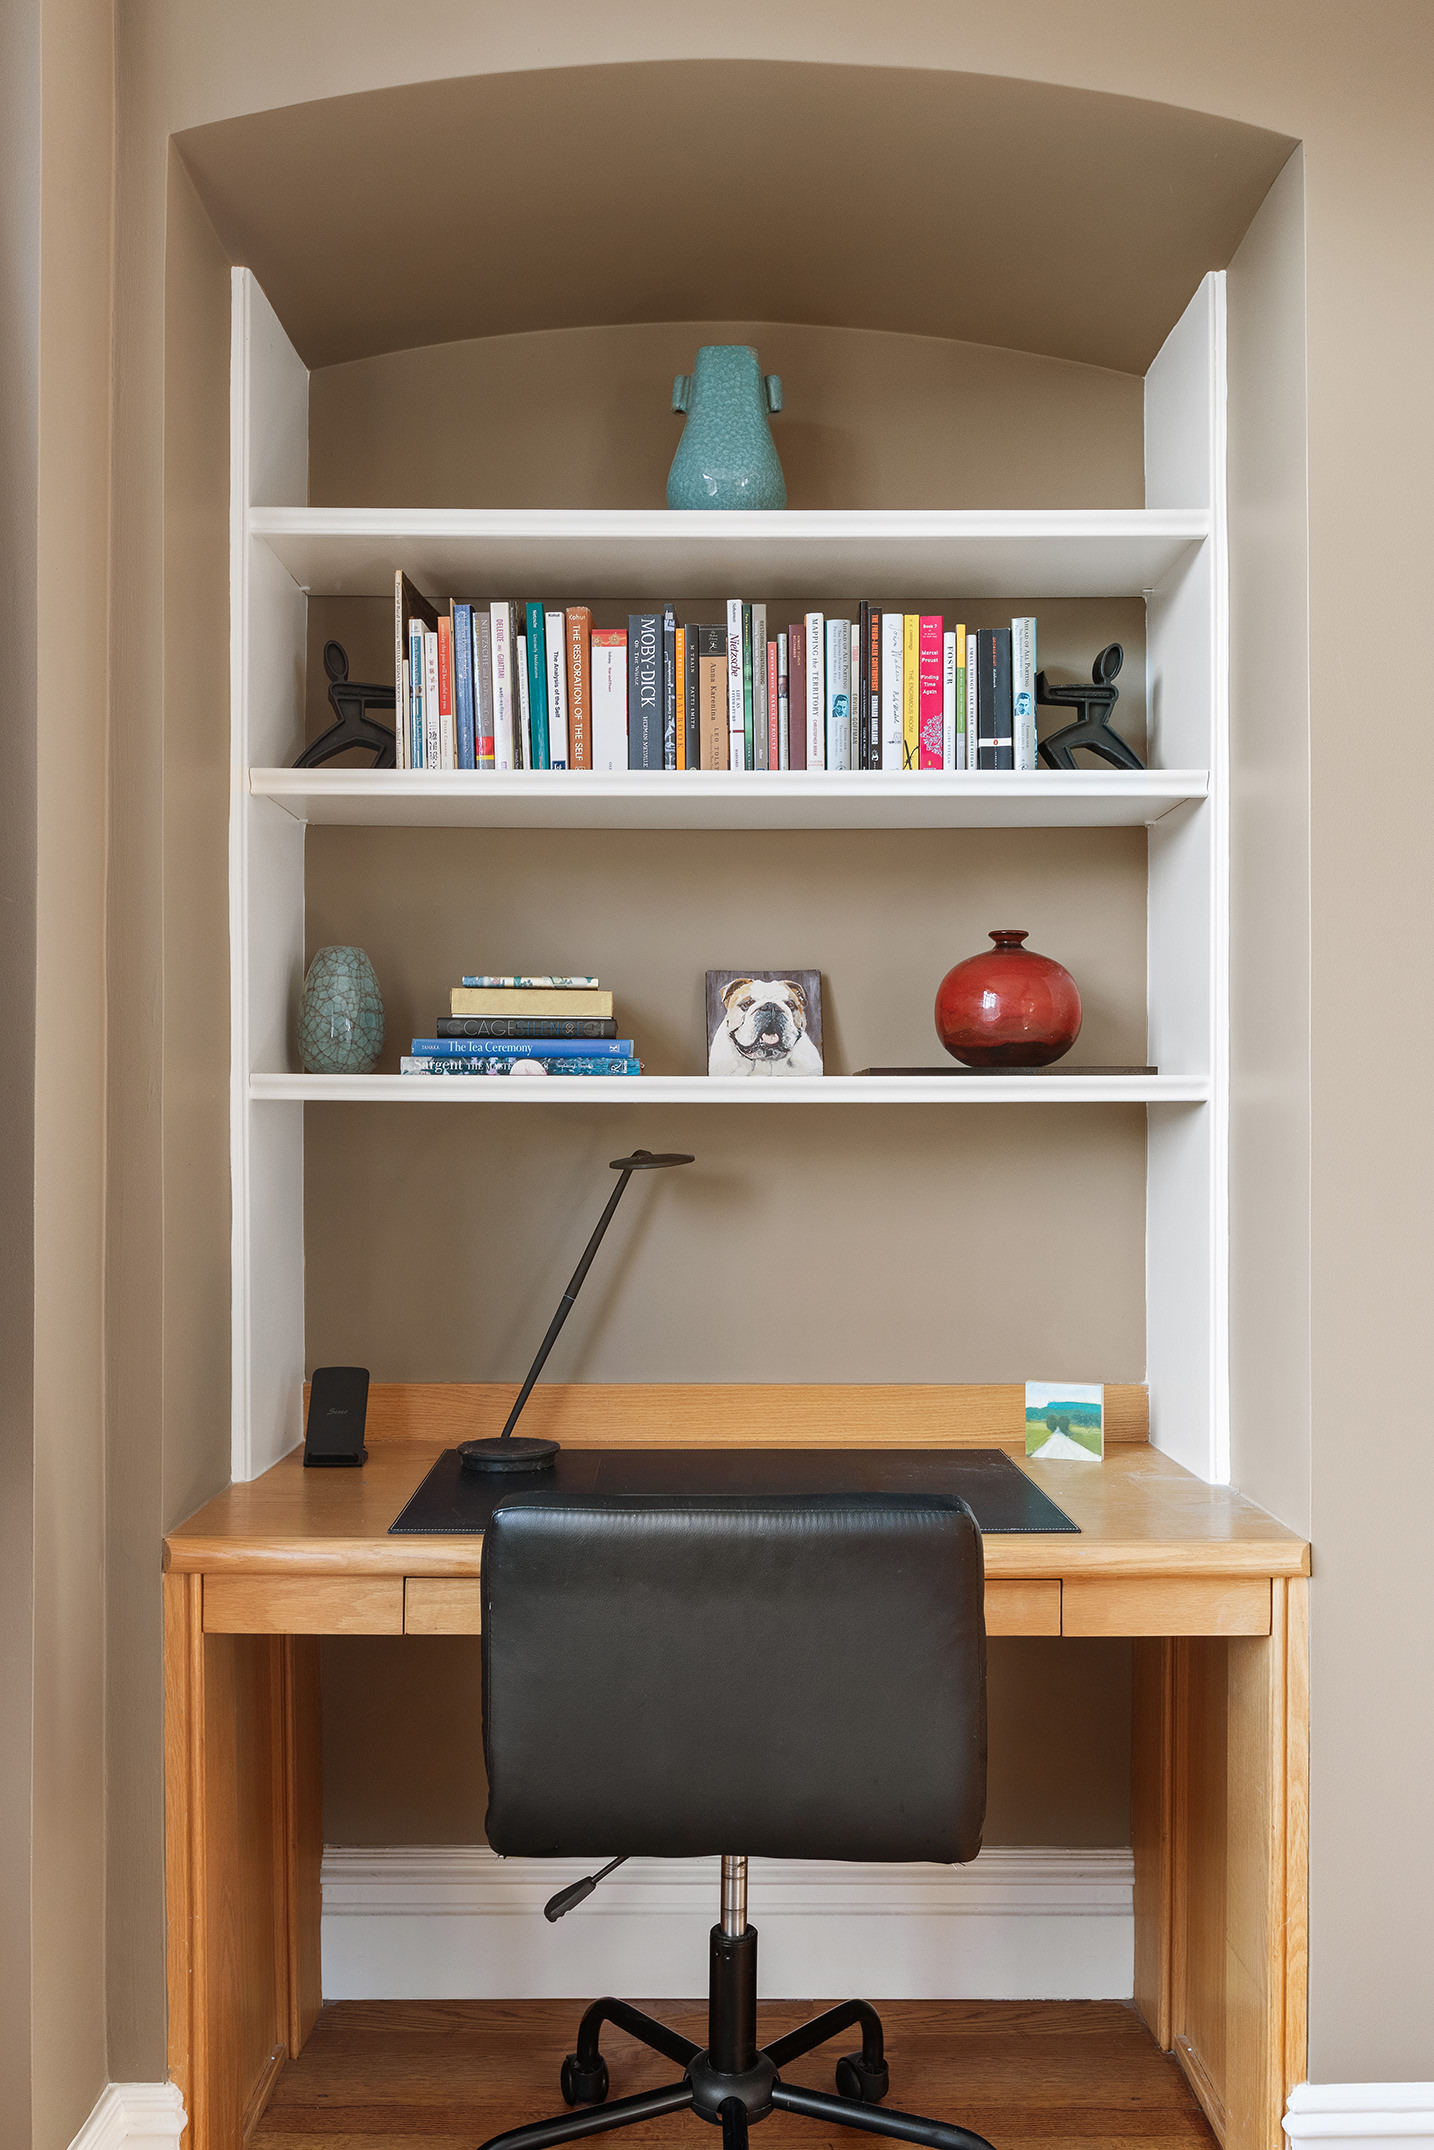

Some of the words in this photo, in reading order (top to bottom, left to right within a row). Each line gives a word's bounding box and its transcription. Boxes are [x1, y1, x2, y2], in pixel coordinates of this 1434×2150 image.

[871, 614, 879, 624] THE
[496, 618, 504, 642] DELEUZE
[572, 624, 581, 641] THE
[842, 642, 848, 650] OF
[871, 624, 879, 656] FREUD-ADLER
[1024, 640, 1030, 648] OF
[640, 618, 656, 708] MOBY-DICK
[730, 633, 741, 677] Nietzsche
[574, 644, 582, 704] RESTORATION
[871, 657, 879, 692] CONTROVERSY
[946, 646, 954, 685] FOSTER
[710, 686, 718, 721] Karenina
[812, 671, 820, 717] TERRITORY
[574, 708, 582, 720] OF
[574, 723, 583, 740] THE
[575, 742, 584, 761] SELF
[464, 1020, 519, 1036] CAGE
[517, 1021, 583, 1036] SILENCE
[448, 1041, 466, 1052] The
[467, 1041, 482, 1052] Tea
[485, 1041, 533, 1056] Ceremony
[414, 1060, 462, 1074] Sargent
[464, 1062, 484, 1070] THE
